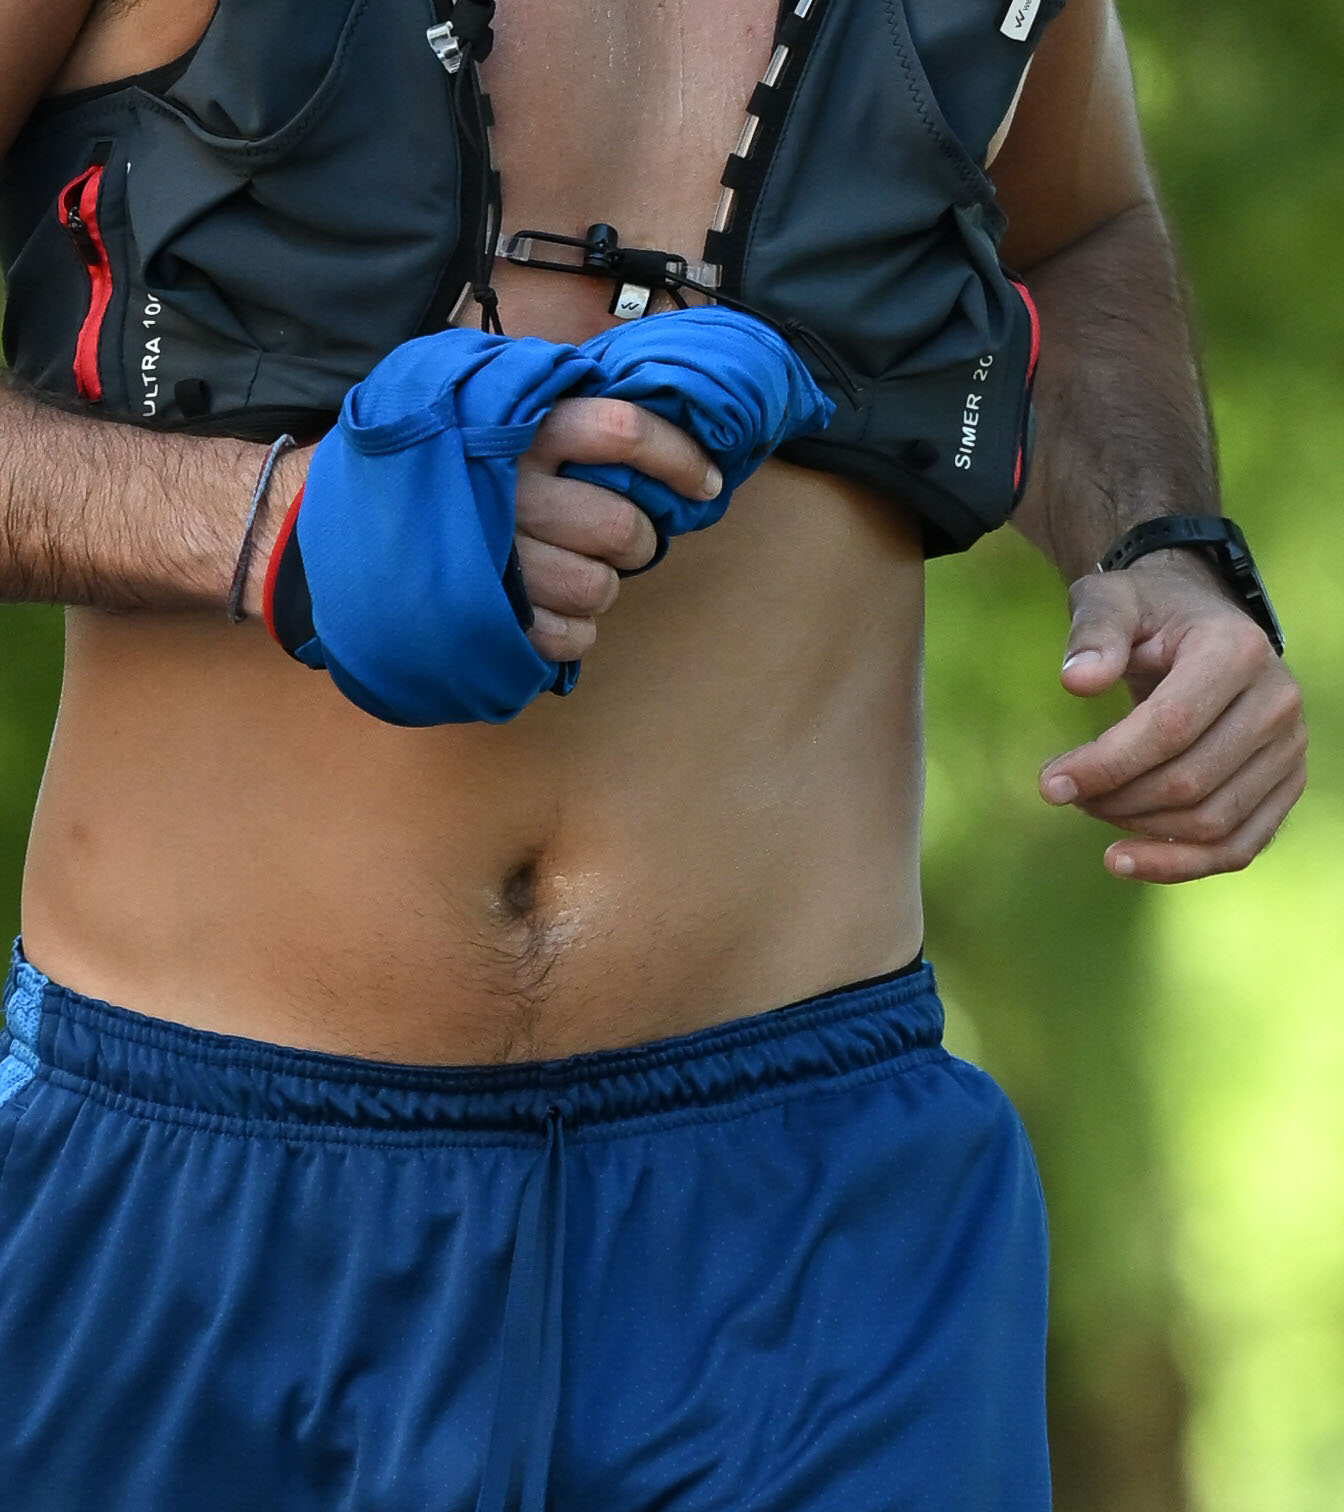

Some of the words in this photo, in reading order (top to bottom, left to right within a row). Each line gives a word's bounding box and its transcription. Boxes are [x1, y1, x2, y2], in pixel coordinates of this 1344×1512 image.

[142, 292, 162, 329] 10
[141, 336, 162, 418] ULTRA
[954, 392, 984, 470] SIMER
